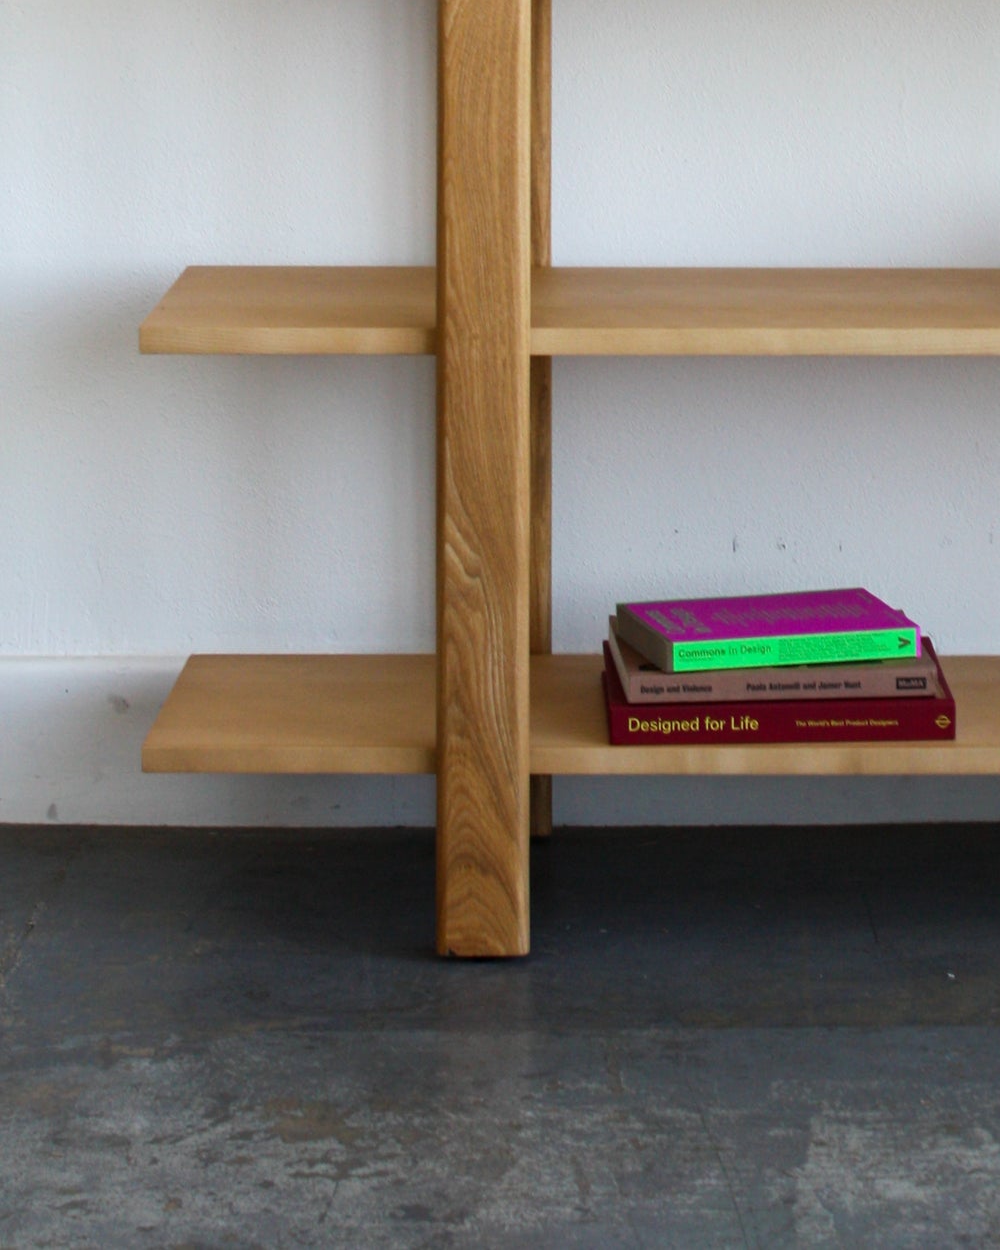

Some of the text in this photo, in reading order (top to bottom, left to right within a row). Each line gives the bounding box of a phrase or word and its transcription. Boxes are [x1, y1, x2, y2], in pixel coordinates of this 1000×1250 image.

[678, 647, 726, 658] Commons
[740, 643, 771, 655] Design
[628, 716, 759, 734] Designed for Life
